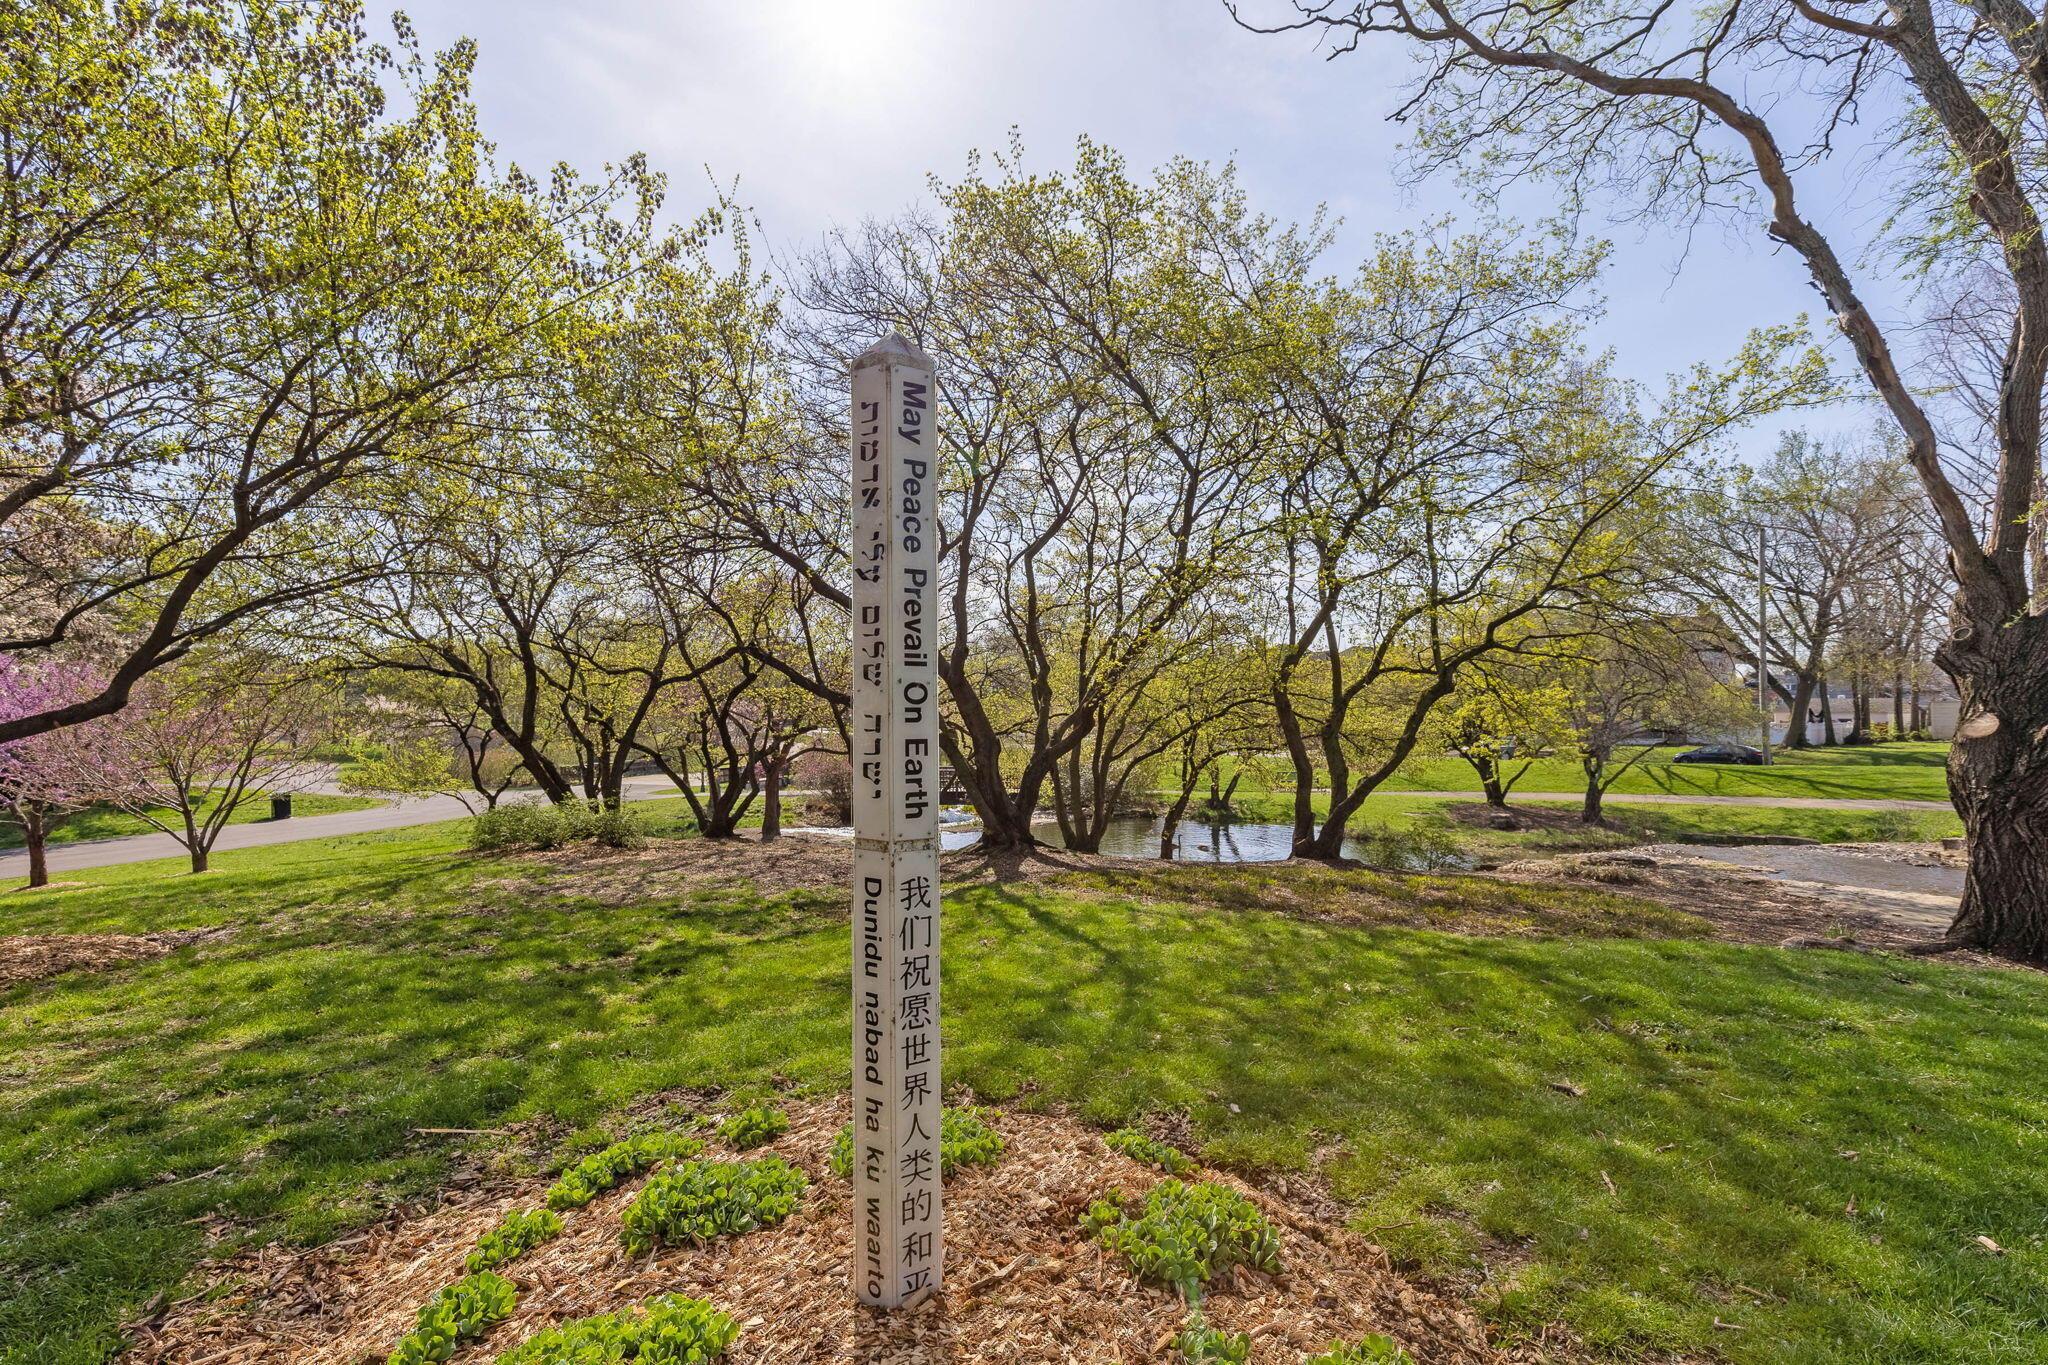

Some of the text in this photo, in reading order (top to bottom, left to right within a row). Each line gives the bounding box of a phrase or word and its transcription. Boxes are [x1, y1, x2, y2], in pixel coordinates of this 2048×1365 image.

[855, 401, 885, 799] ישרה שלום עלי אדמות
[898, 381, 929, 819] May Peace Prevail On Earth
[864, 877, 885, 1299] Dunidu nabad ha ku waarto
[899, 875, 934, 1297] 我们祝愿世界人类的和平
